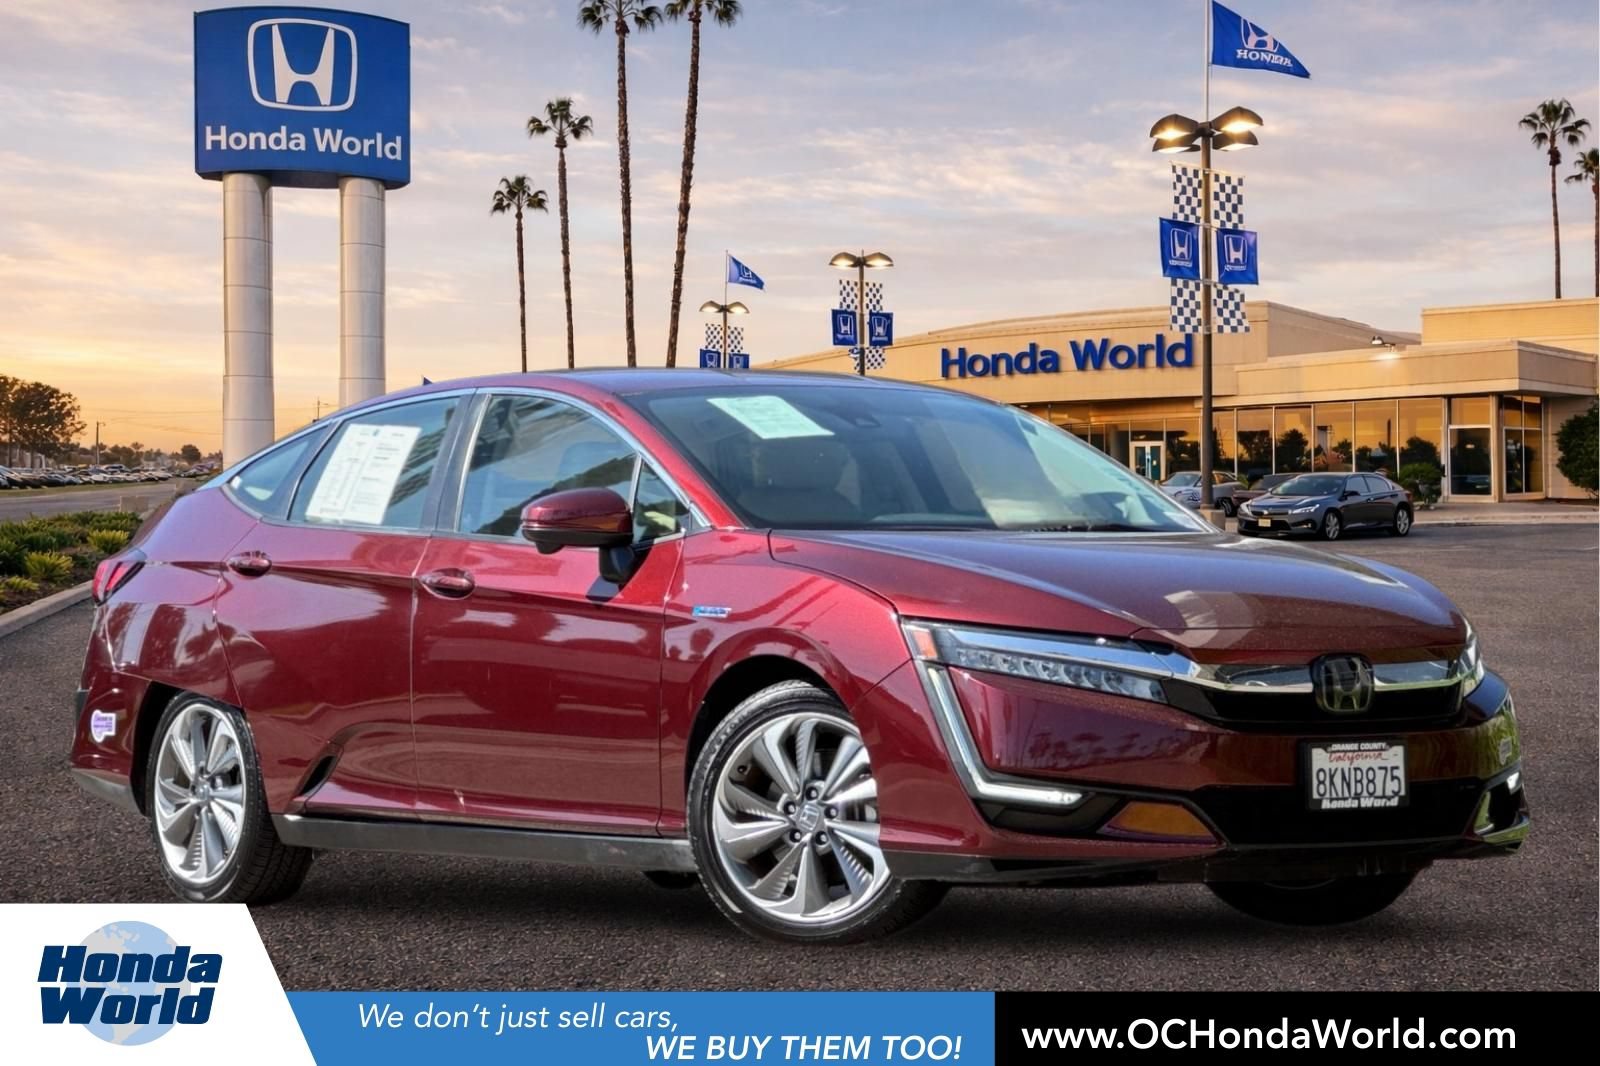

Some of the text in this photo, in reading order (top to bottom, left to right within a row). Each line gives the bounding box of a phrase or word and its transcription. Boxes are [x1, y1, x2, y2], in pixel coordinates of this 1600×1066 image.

[205, 125, 402, 160] Honda World
[941, 333, 1194, 379] Honda World
[1328, 752, 1384, 765] California
[1360, 742, 1387, 750] COUNTY
[1316, 766, 1402, 797] 8KNB875
